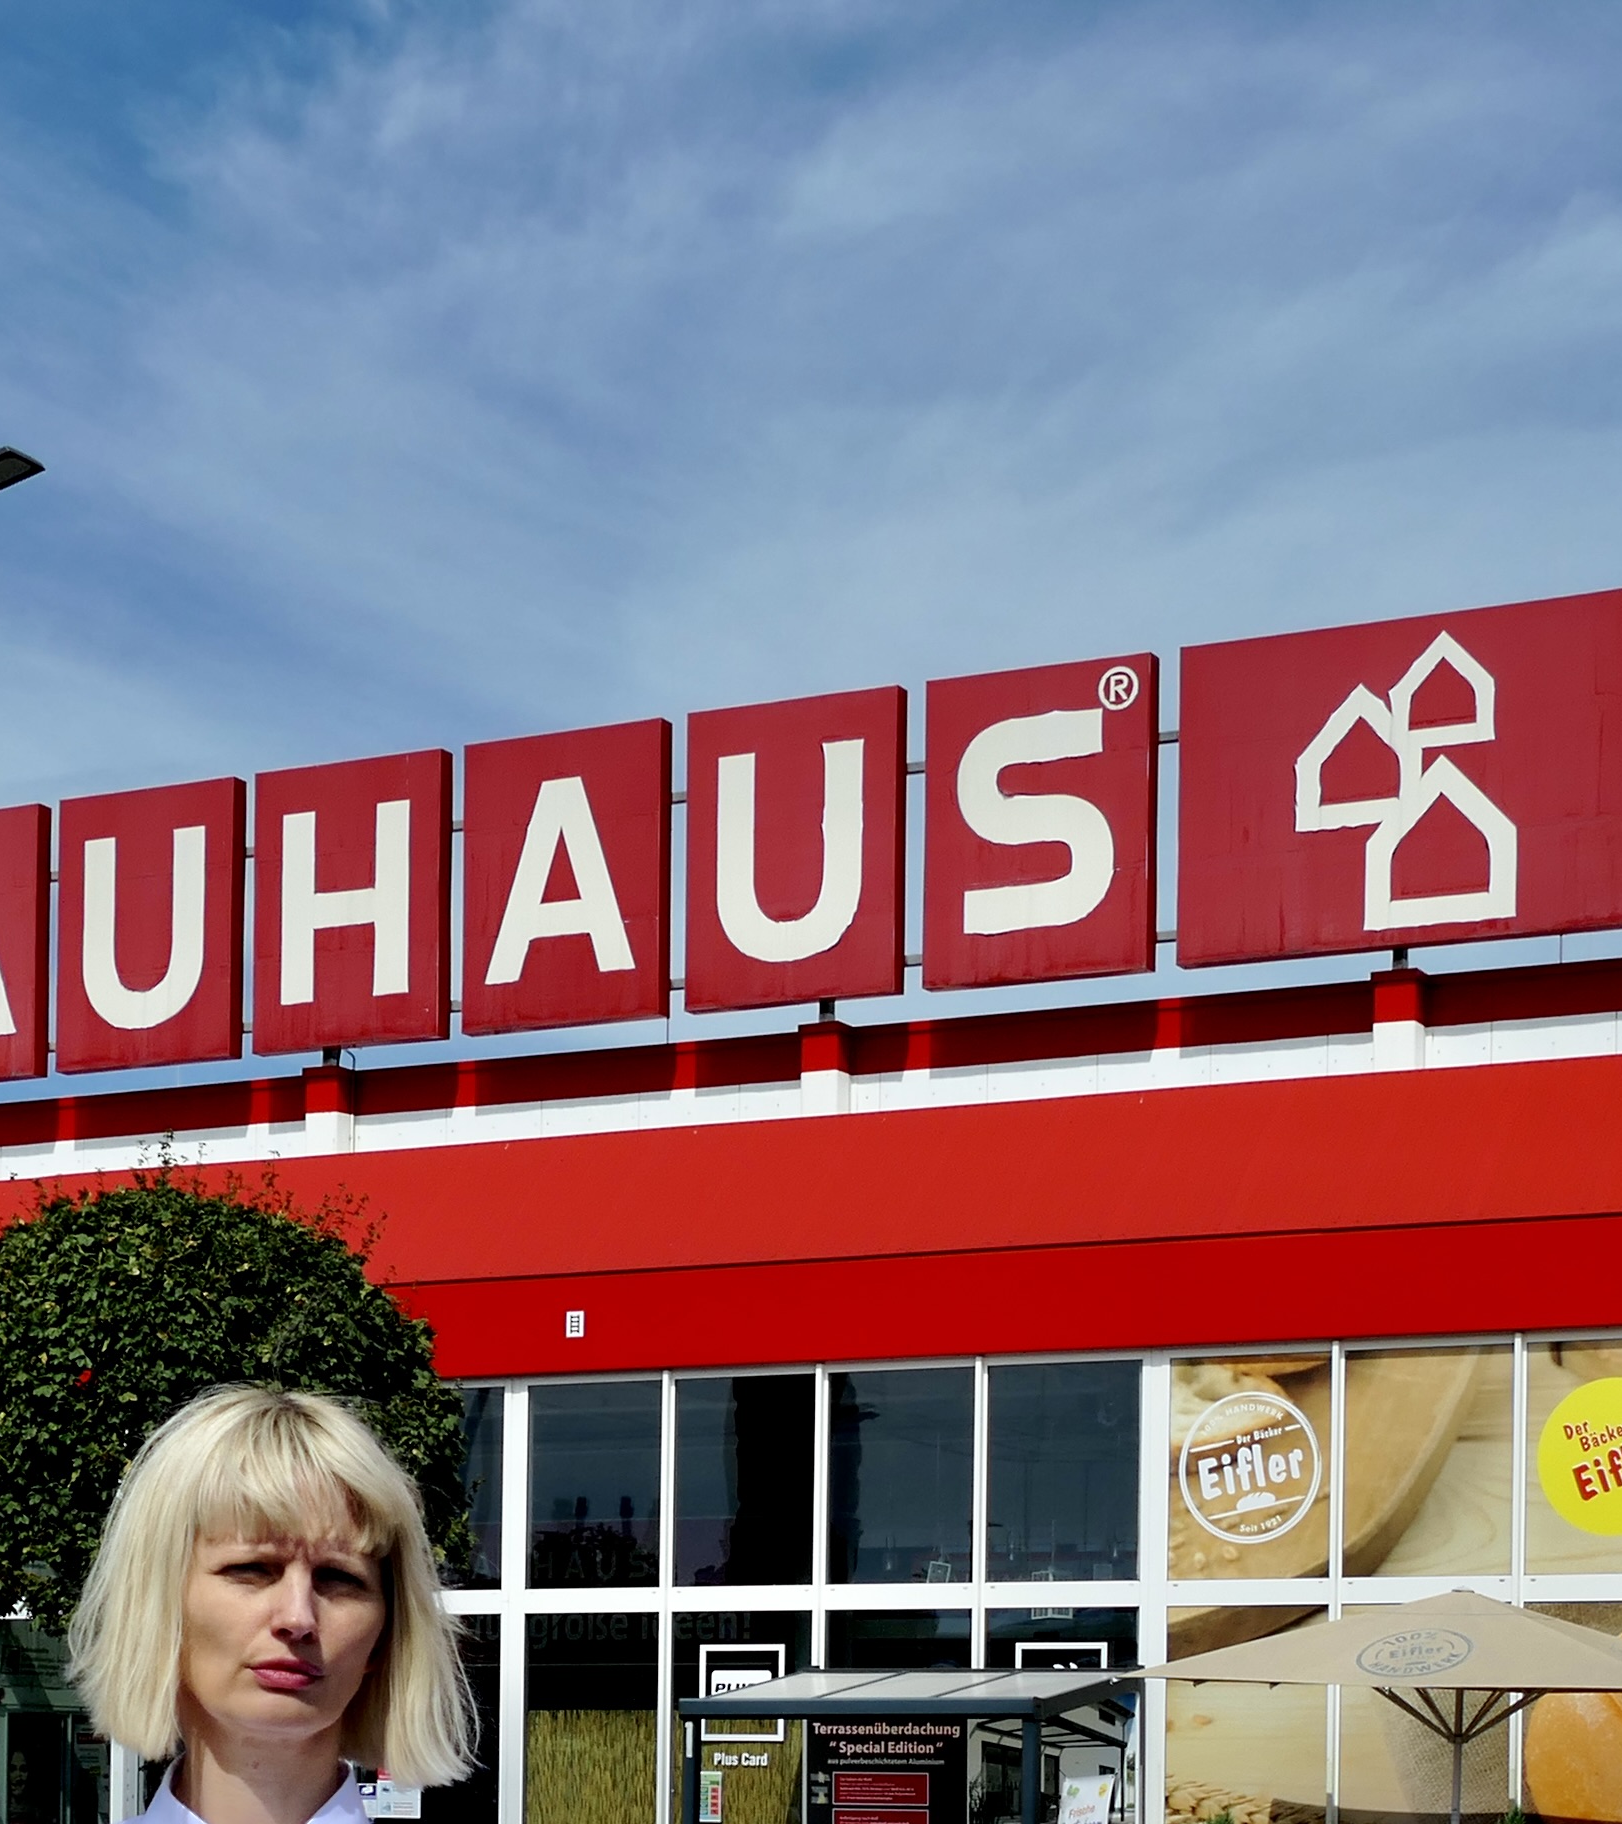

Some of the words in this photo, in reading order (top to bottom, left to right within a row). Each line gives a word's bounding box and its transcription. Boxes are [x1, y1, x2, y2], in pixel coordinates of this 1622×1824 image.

[1563, 1421, 1589, 1440] Der
[1197, 1443, 1304, 1501] Eifler
[1389, 1645, 1444, 1659] Eifler
[812, 1722, 961, 1738] Terrassenüberdachung
[838, 1741, 885, 1756] Special
[887, 1740, 934, 1754] Edition
[713, 1752, 739, 1767] Plus
[741, 1752, 768, 1767] Card
